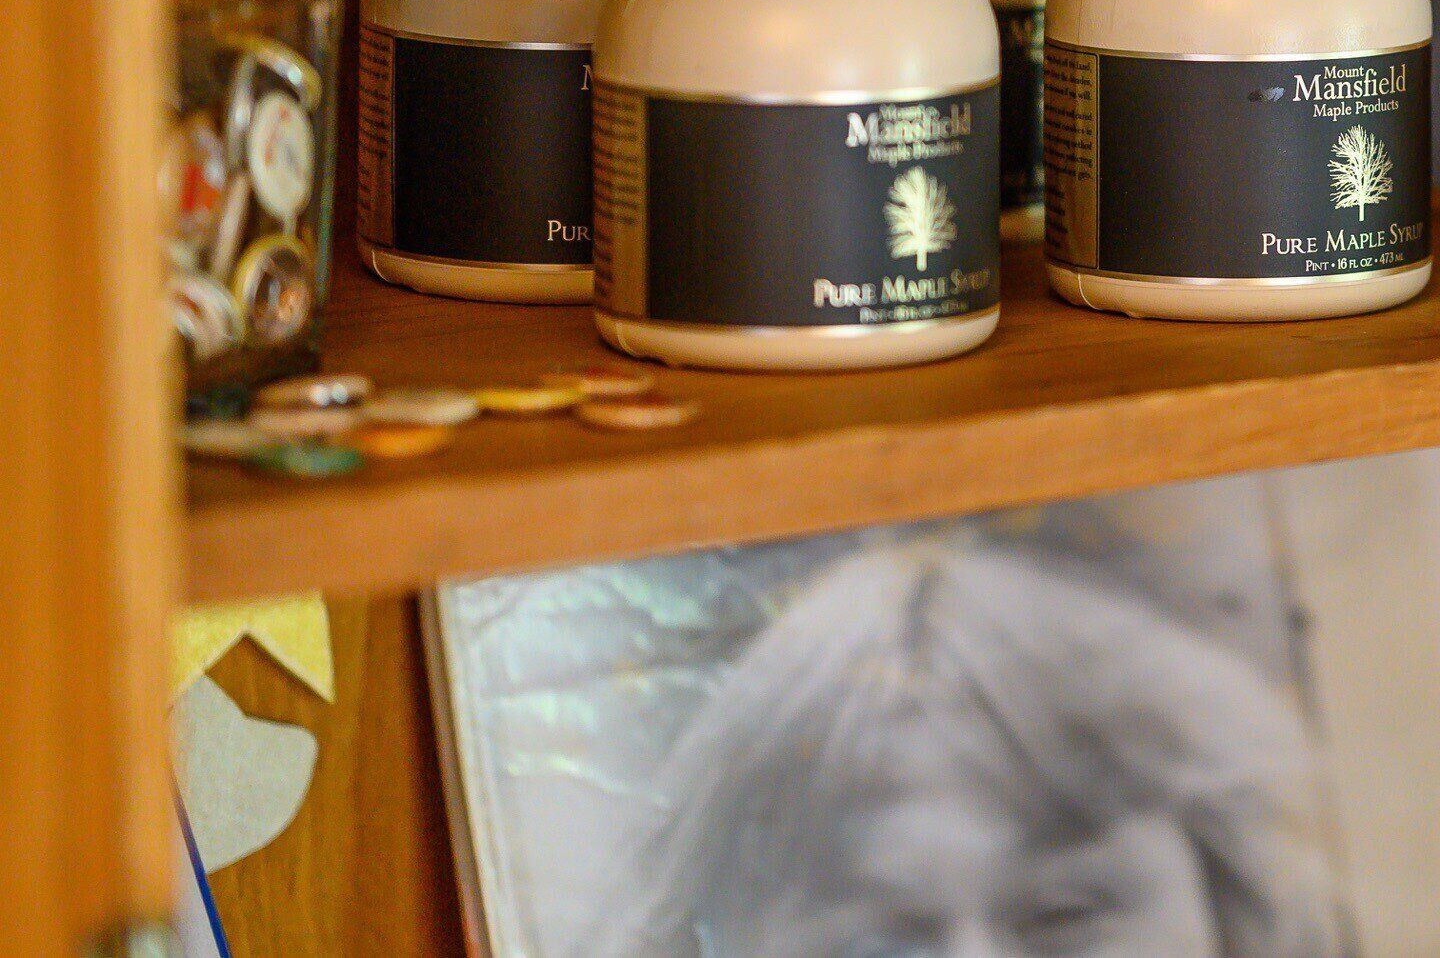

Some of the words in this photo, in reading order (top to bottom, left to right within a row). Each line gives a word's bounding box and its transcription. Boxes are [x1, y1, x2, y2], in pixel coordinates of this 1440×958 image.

[1292, 64, 1407, 101] Mansfield
[1324, 65, 1364, 79] Mount
[1313, 102, 1352, 121] Maple
[1355, 98, 1399, 115] Products
[845, 102, 971, 147] Mansfield
[547, 220, 591, 241] PUR
[1262, 233, 1318, 255] PURE
[1325, 229, 1387, 252] MAPLE
[1337, 258, 1347, 270] 16
[1379, 253, 1395, 265] 473
